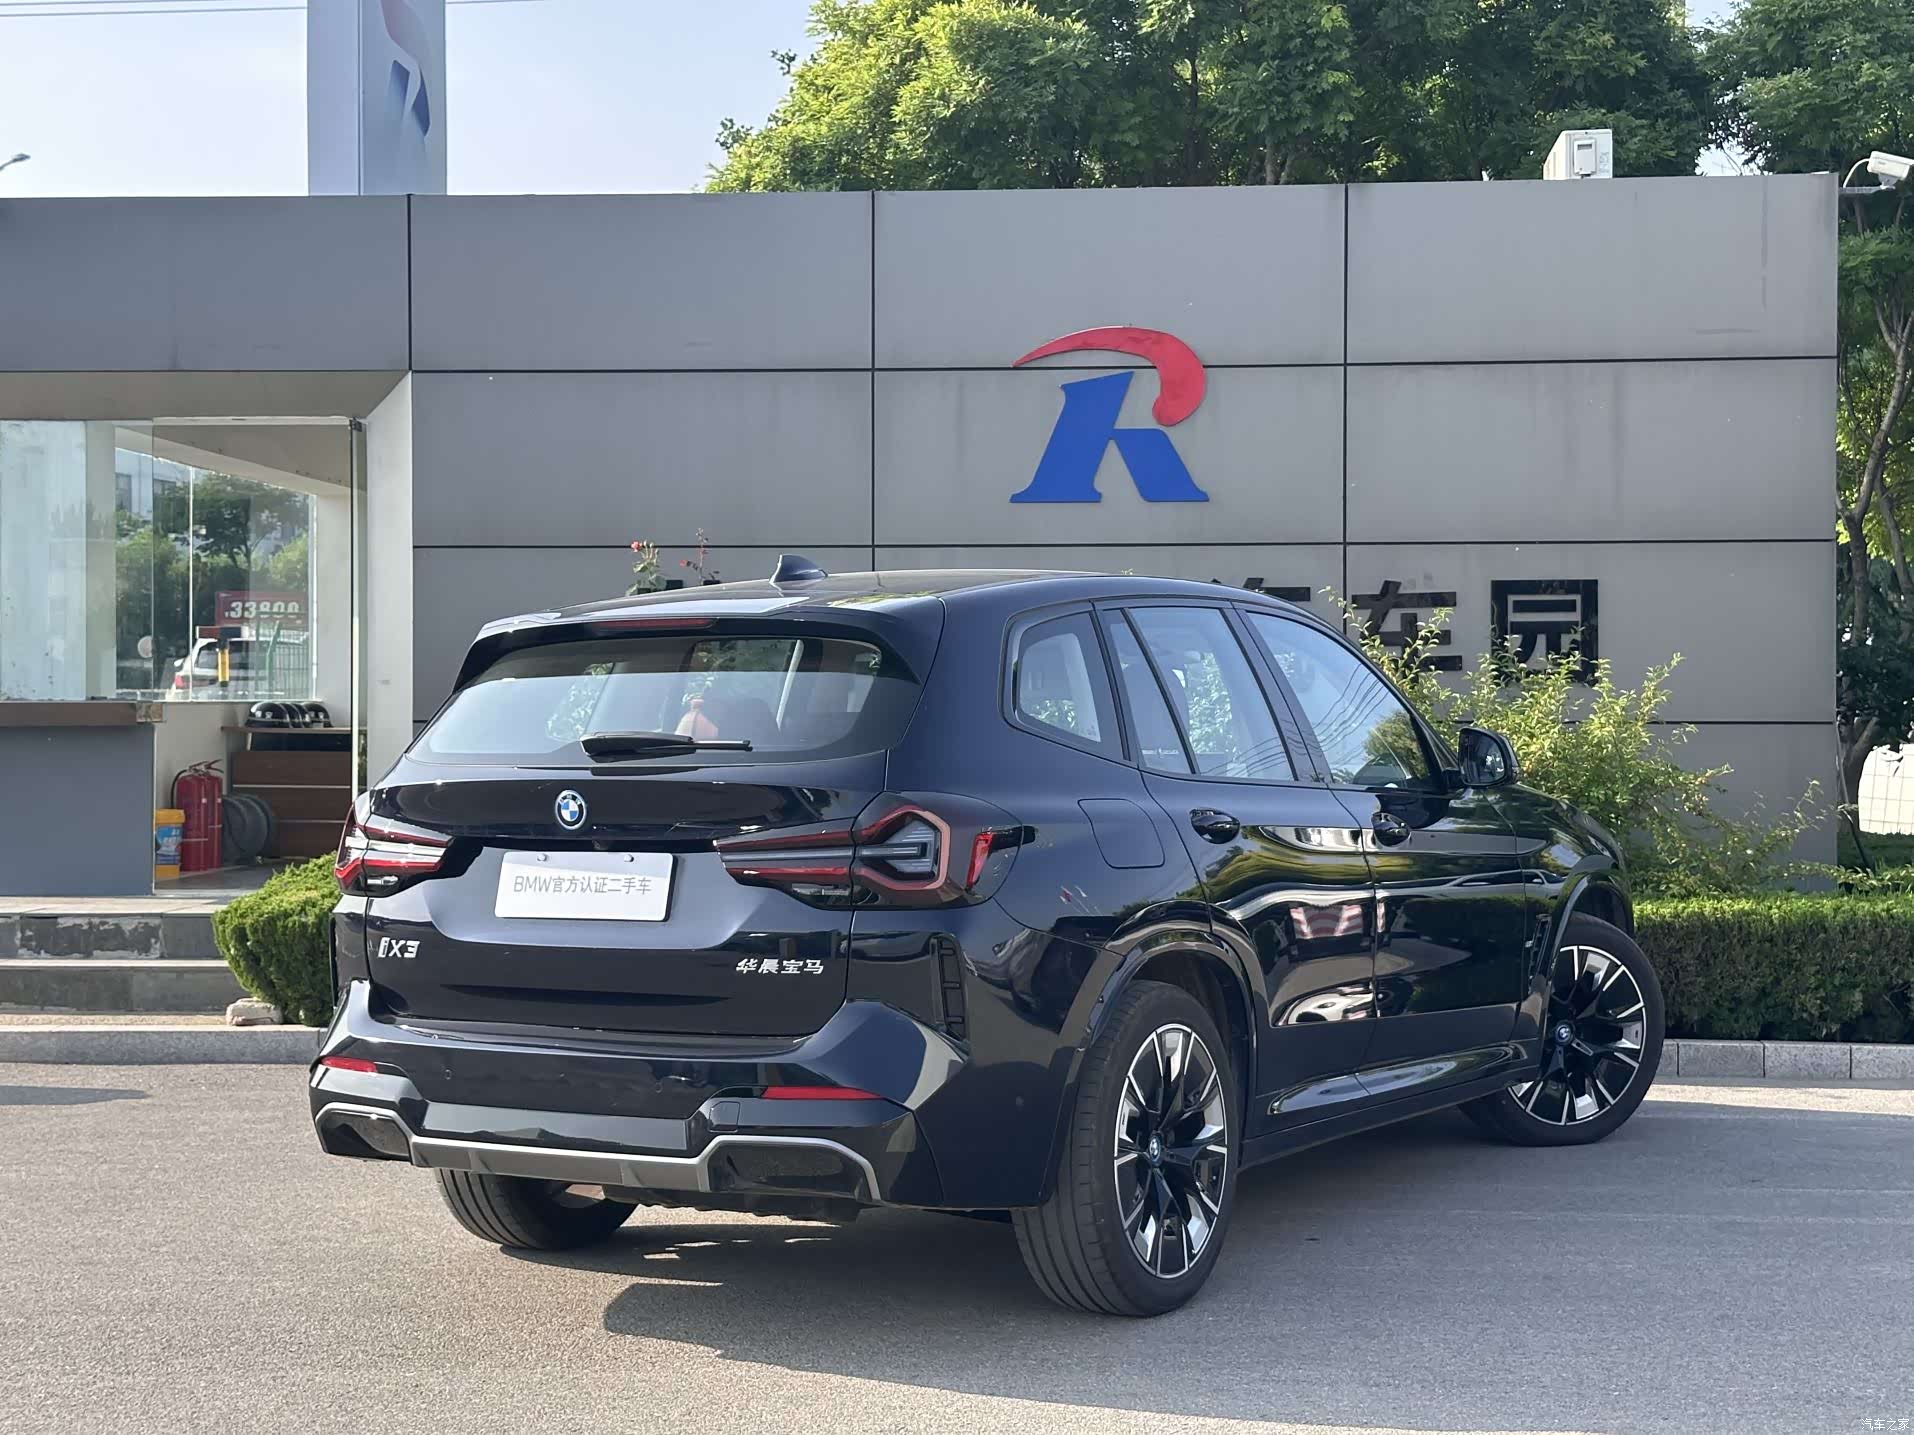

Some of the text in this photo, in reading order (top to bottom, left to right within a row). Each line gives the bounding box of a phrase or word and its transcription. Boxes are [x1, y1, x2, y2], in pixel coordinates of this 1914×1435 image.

[513, 875, 652, 895] BMW官方认证二手车
[378, 936, 420, 958] iX3
[735, 958, 824, 975] 华晨宝马
